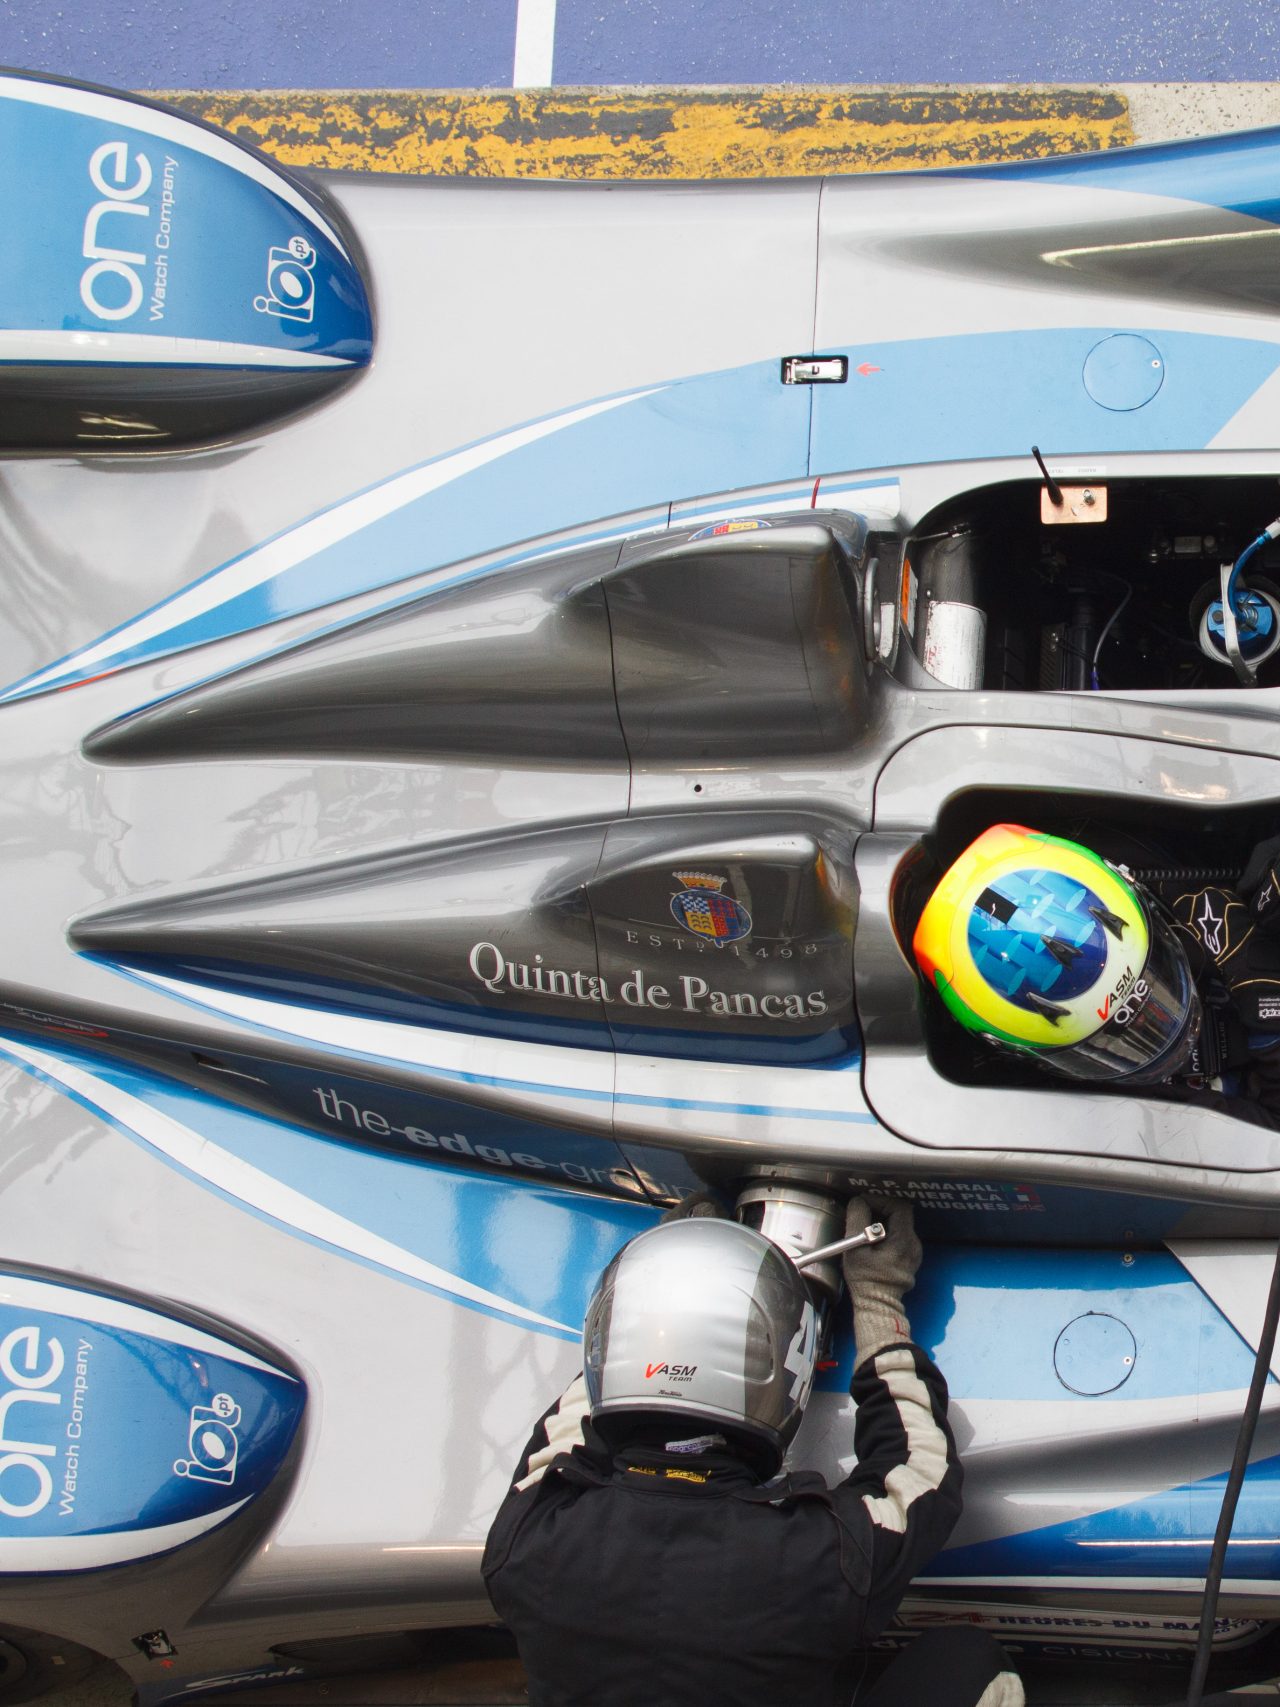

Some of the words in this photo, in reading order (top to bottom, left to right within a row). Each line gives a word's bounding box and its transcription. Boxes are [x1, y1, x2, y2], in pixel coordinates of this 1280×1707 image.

[80, 142, 152, 320] one
[155, 155, 180, 250] Company
[149, 251, 171, 322] Watch
[469, 942, 614, 1003] Quinta
[620, 970, 671, 1011] de
[679, 976, 830, 1018] Pancas
[733, 943, 819, 961] 1498
[1114, 979, 1150, 1025] one
[907, 1180, 998, 1194] AMARAL
[920, 1200, 1011, 1212] HUGHES
[961, 1193, 1004, 1203] PLA
[0, 1326, 65, 1518] one
[66, 1338, 93, 1438] Company
[58, 1444, 81, 1517] Watch
[1112, 1619, 1150, 1630] DU
